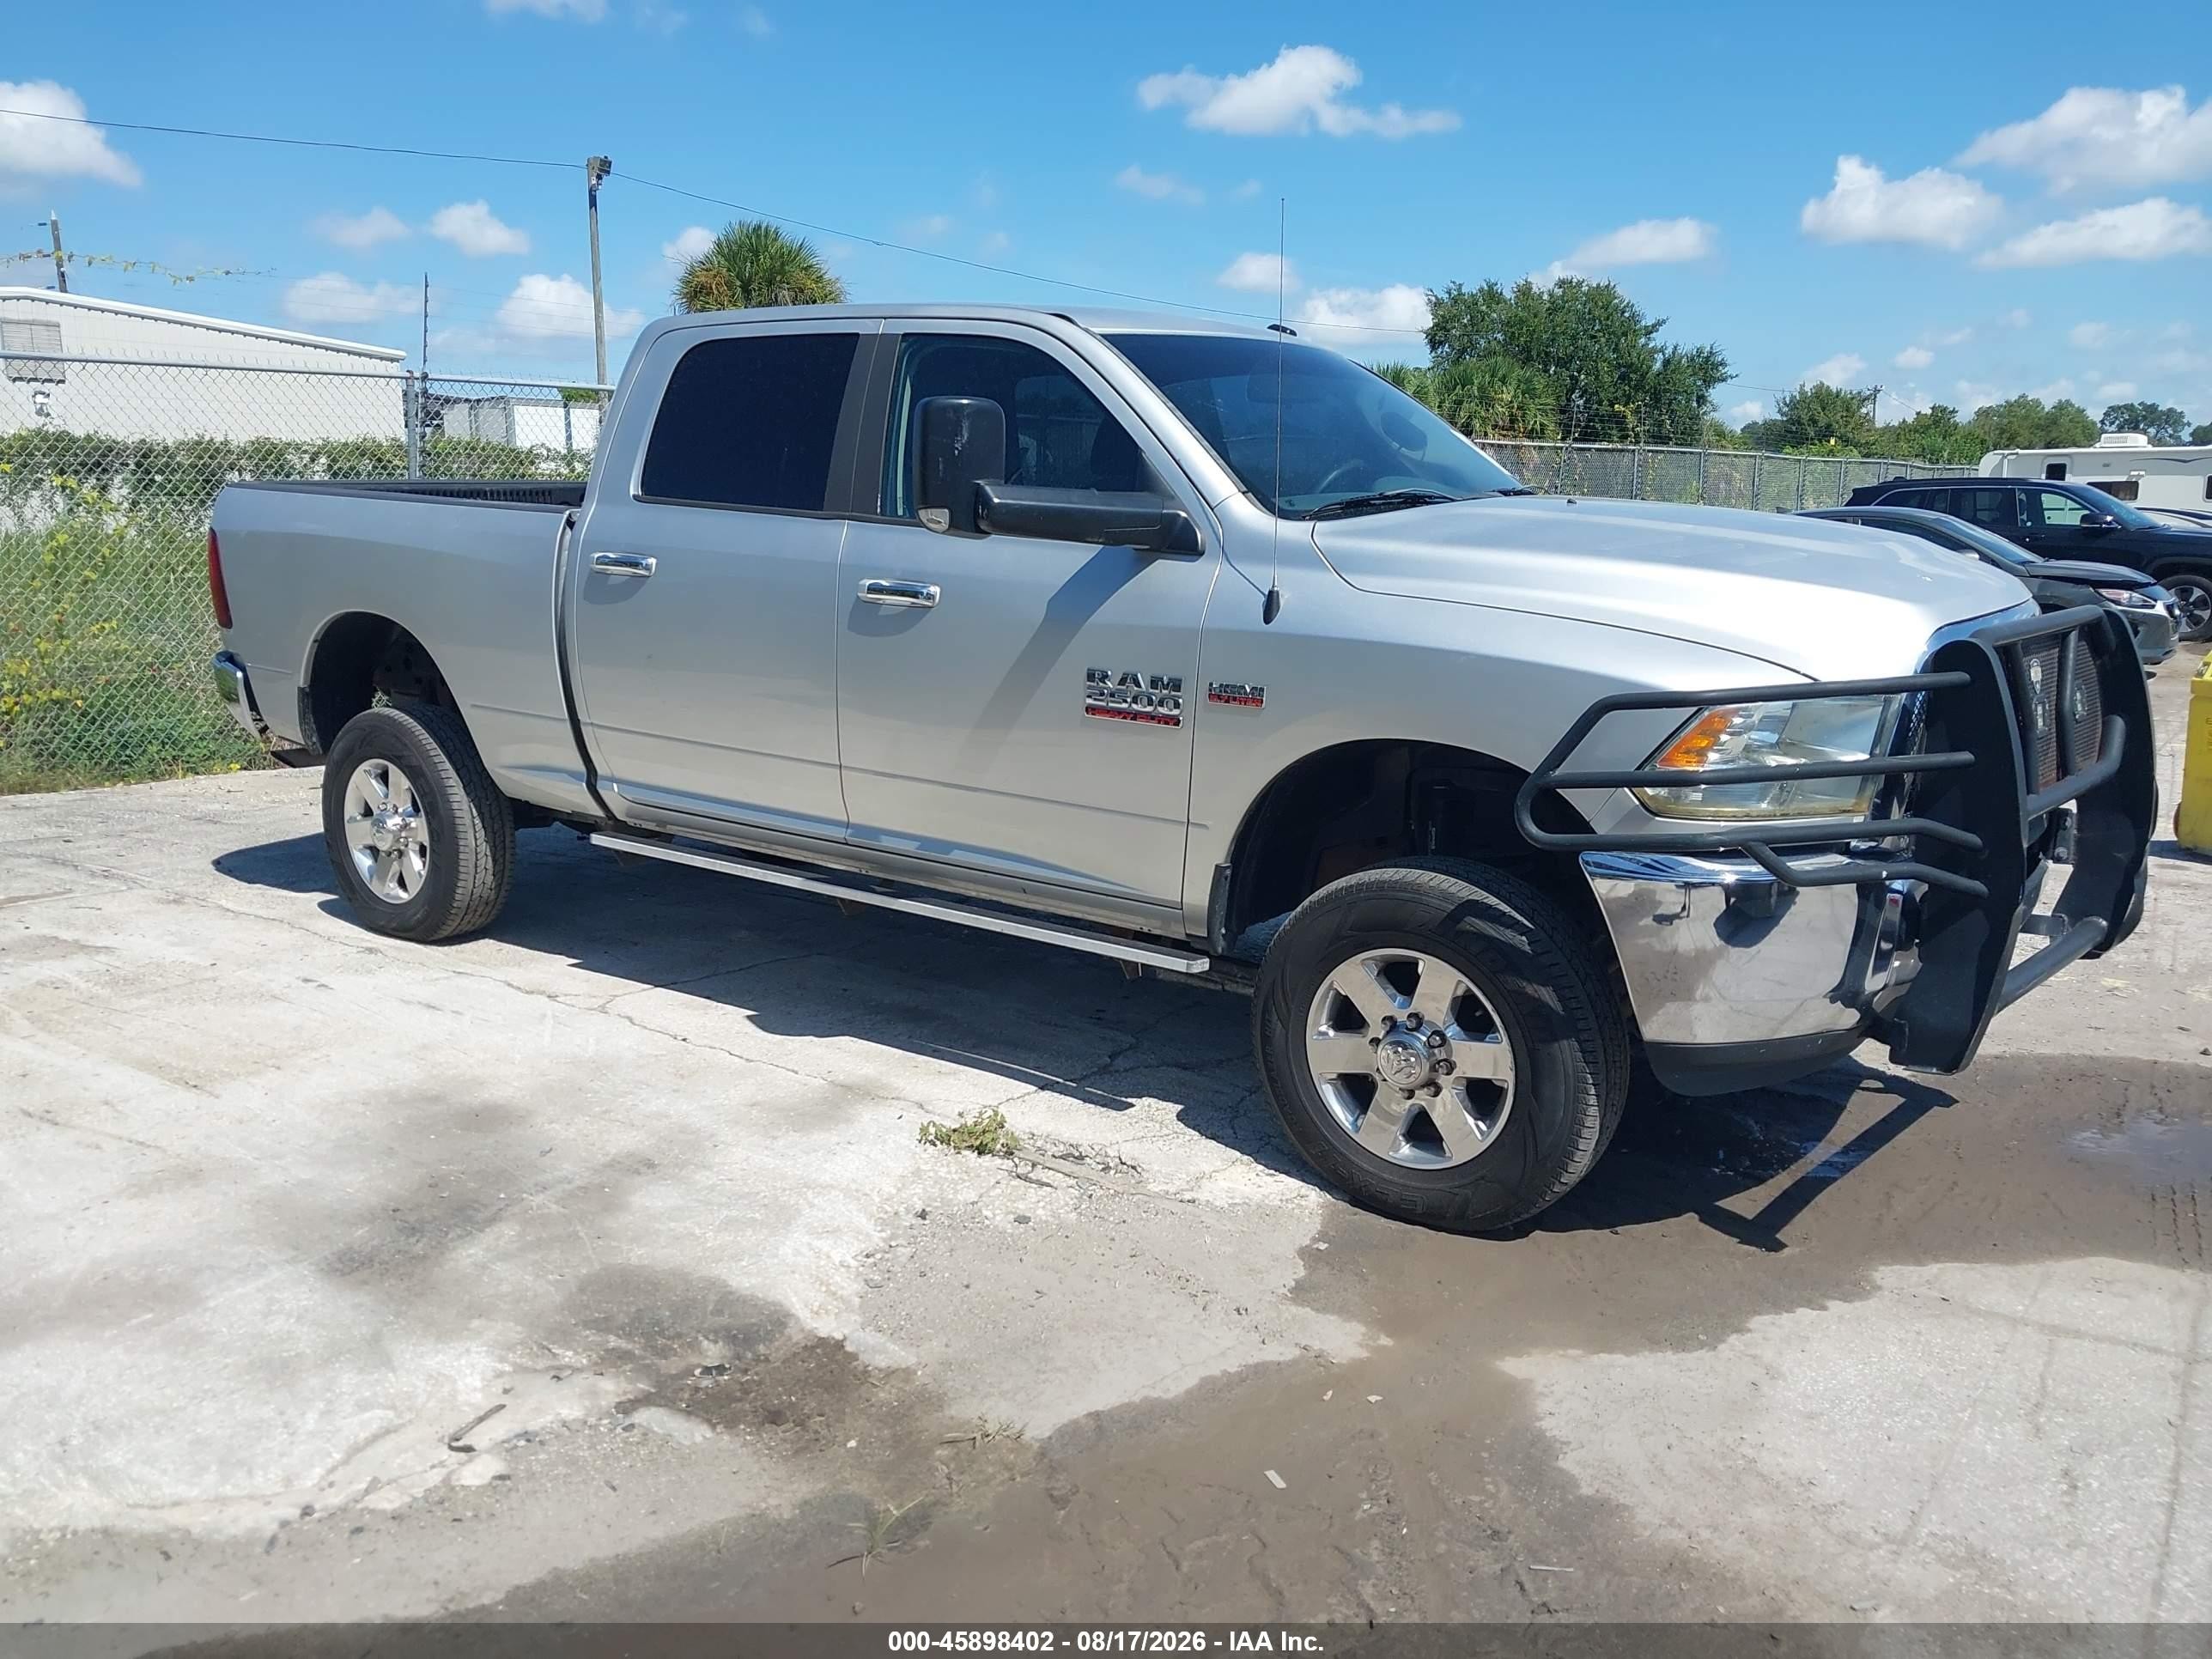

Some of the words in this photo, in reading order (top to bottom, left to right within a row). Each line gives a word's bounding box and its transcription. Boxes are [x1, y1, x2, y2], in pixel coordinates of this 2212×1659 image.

[1085, 668, 1182, 696] RAM
[1208, 682, 1267, 698] HEMI
[1085, 687, 1182, 714] 2500
[1087, 707, 1134, 721] HEAVY
[1136, 713, 1180, 726] DUTY
